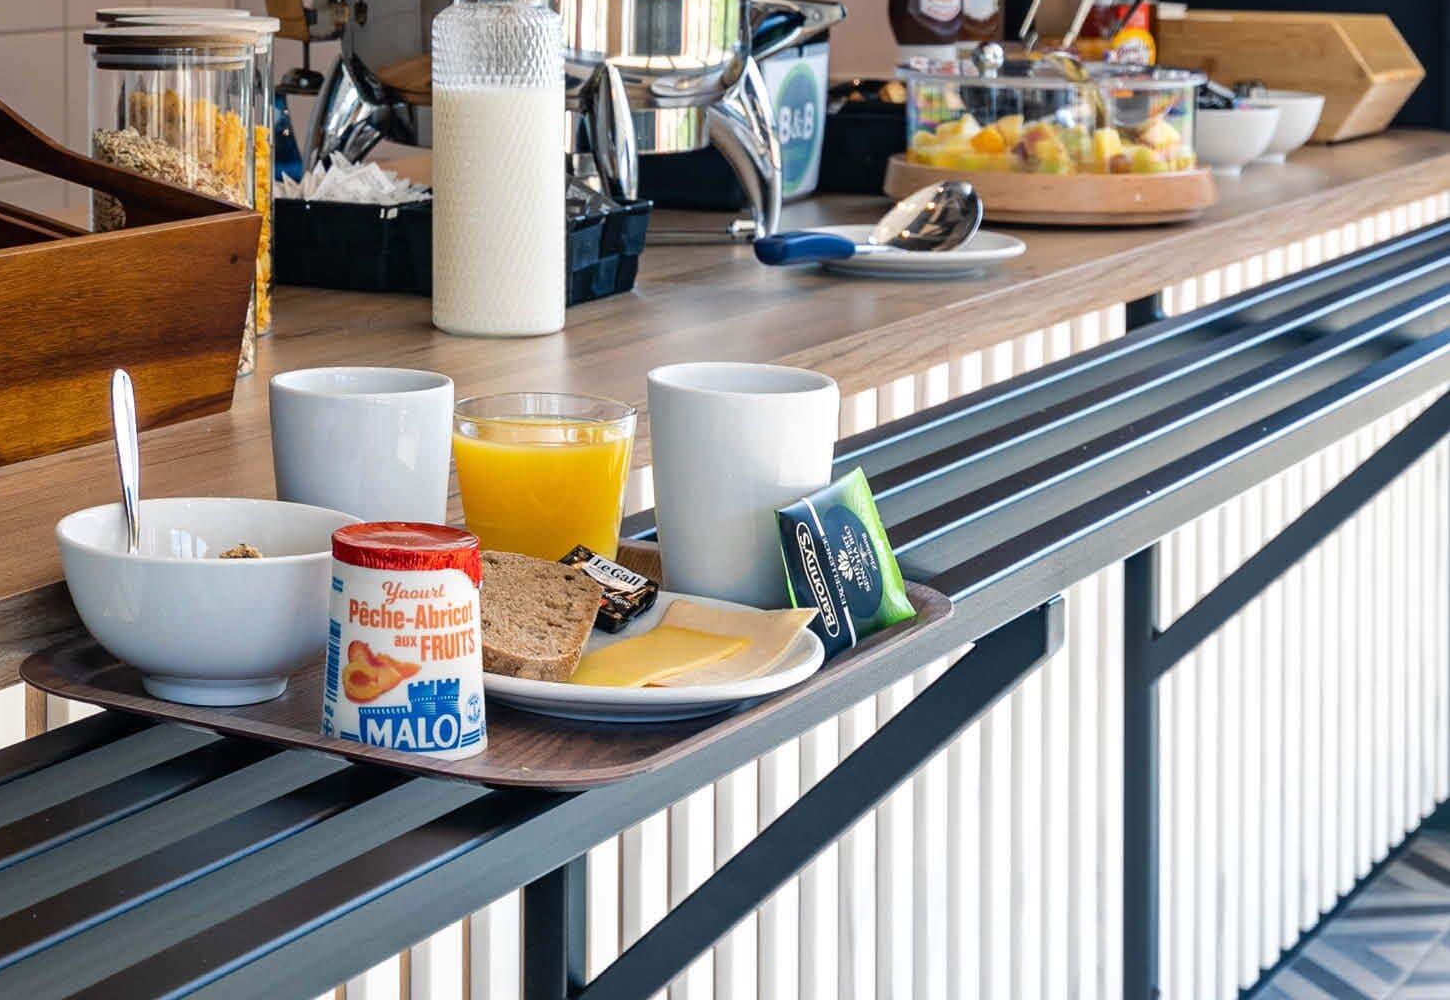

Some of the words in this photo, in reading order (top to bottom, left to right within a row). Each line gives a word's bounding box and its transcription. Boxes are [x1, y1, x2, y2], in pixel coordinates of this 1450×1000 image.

[779, 101, 815, 145] B&B
[593, 559, 610, 571] Le
[610, 568, 641, 586] Gall
[822, 535, 847, 605] EXCELLENCE
[382, 581, 446, 604] Yaourt
[349, 599, 473, 630] Pêche-Abricot
[394, 633, 417, 648] aux
[420, 628, 476, 662] FRUITS
[366, 714, 459, 749] MALO
